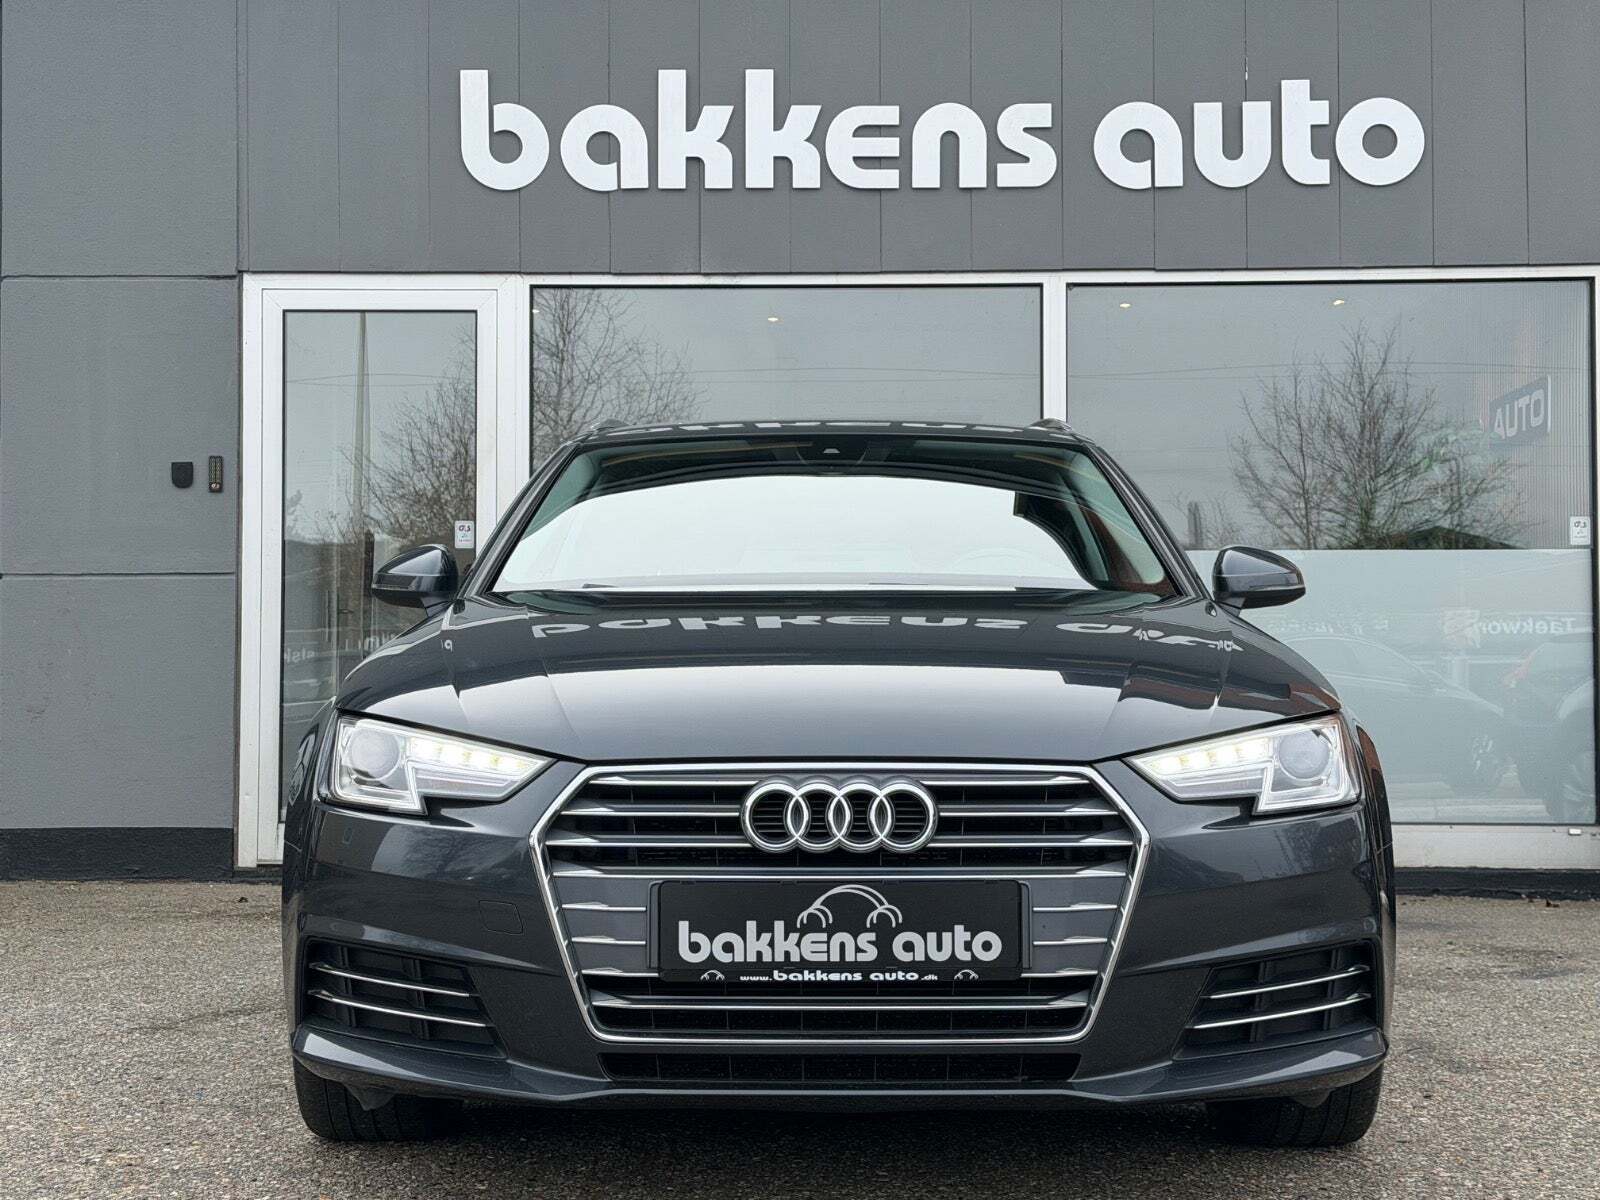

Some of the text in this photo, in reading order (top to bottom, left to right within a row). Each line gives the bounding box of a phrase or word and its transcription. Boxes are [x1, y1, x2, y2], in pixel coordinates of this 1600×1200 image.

[460, 69, 1425, 191] bakkens auto
[1493, 388, 1545, 439] AUTO
[678, 920, 1003, 963] bakkens auto
